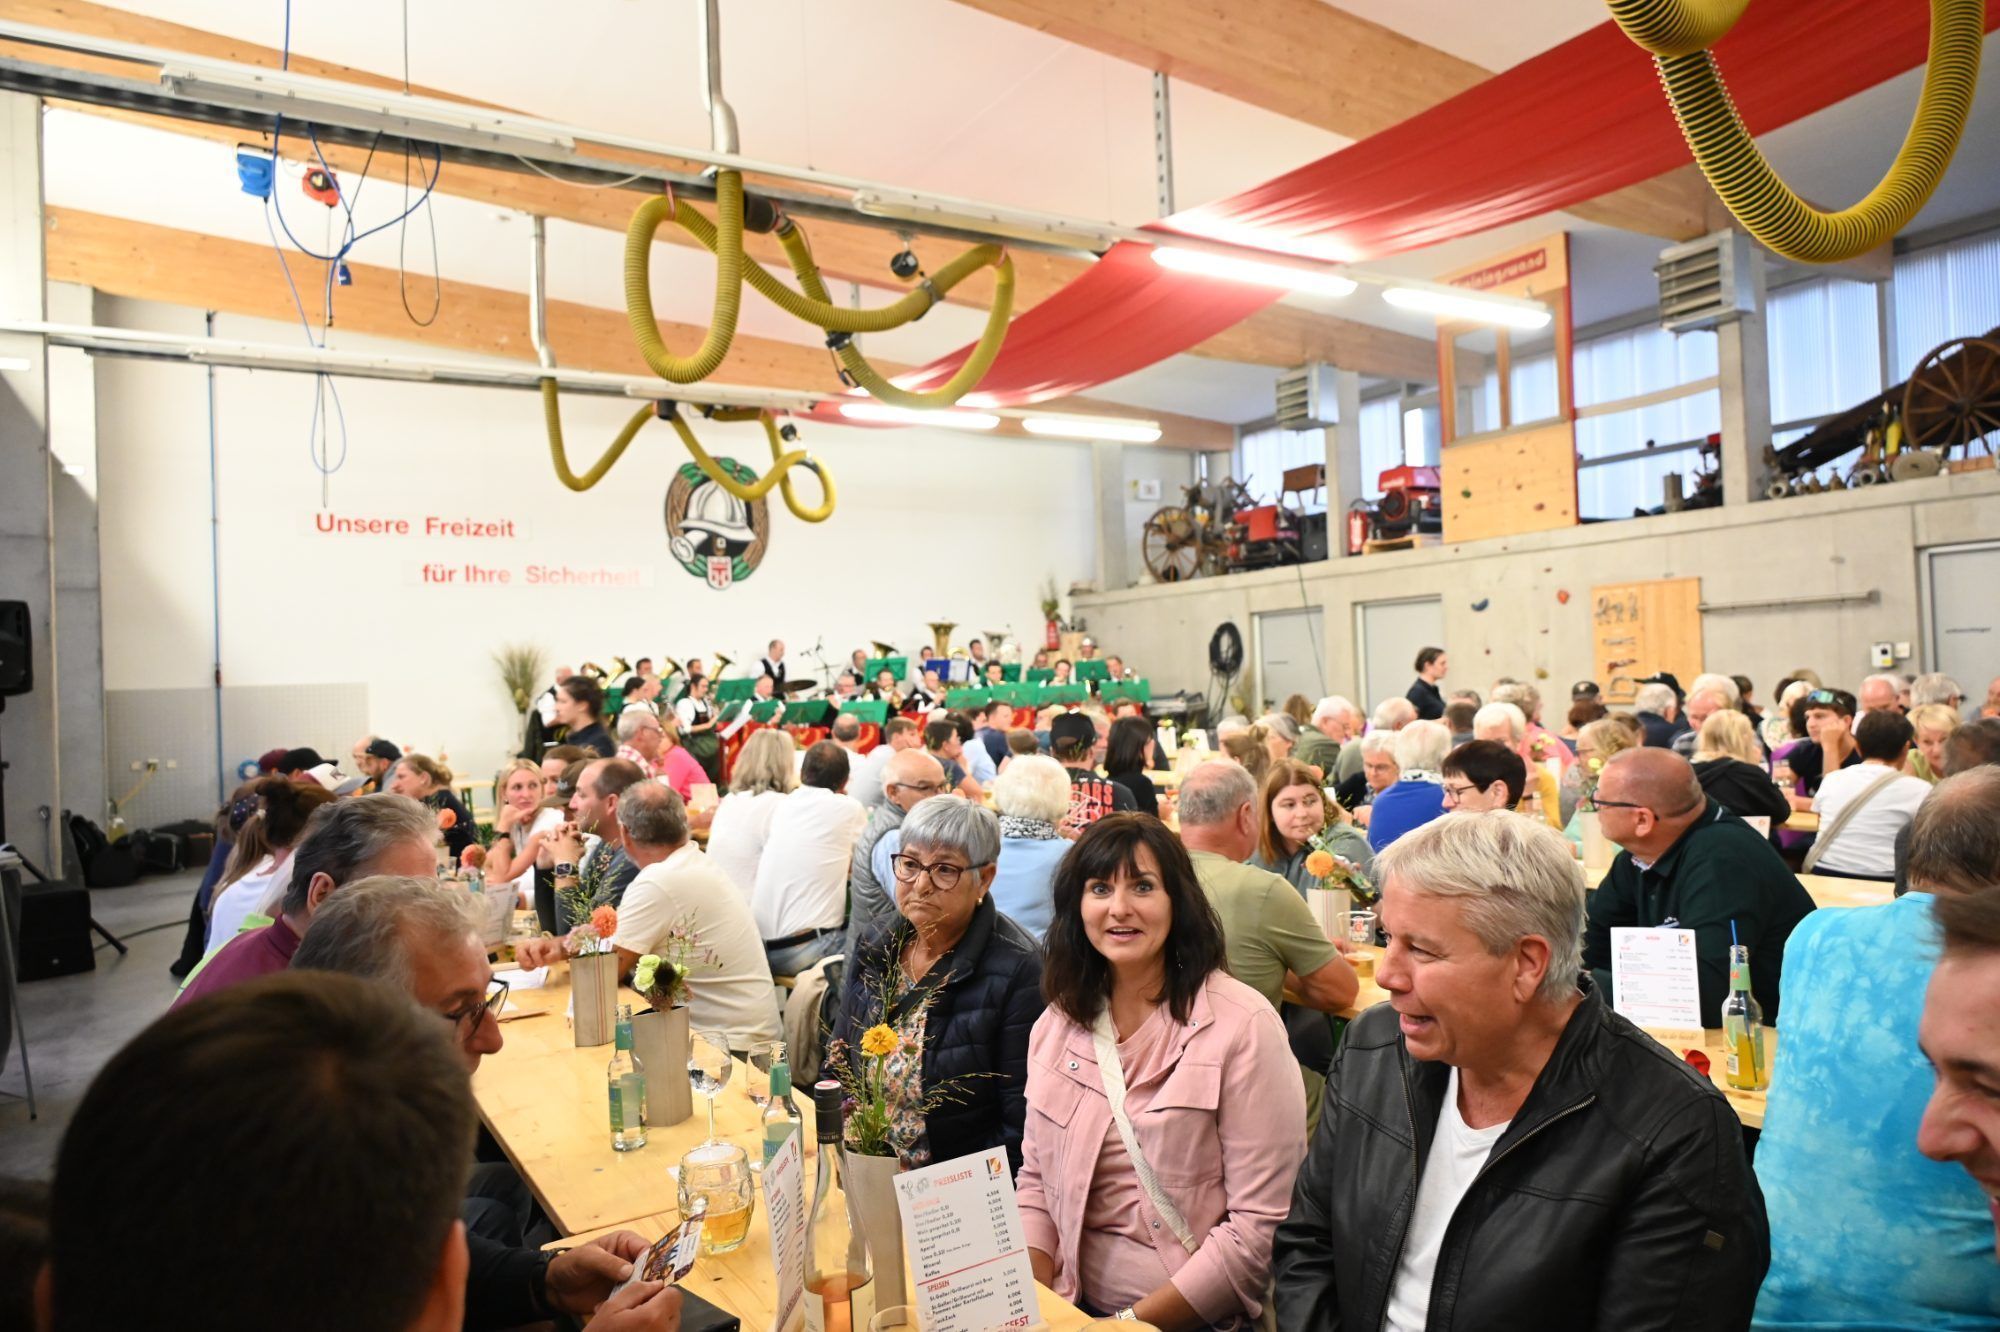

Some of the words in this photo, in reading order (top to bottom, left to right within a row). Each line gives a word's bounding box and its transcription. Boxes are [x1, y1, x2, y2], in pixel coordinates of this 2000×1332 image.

[315, 513, 410, 535] Unsere
[425, 516, 515, 538] Freizeit
[422, 564, 458, 584] für
[465, 565, 511, 585] Ihre
[525, 565, 641, 586] Sicherheit
[935, 1170, 973, 1186] PREISLISTE
[927, 1280, 950, 1292] SPEISEN
